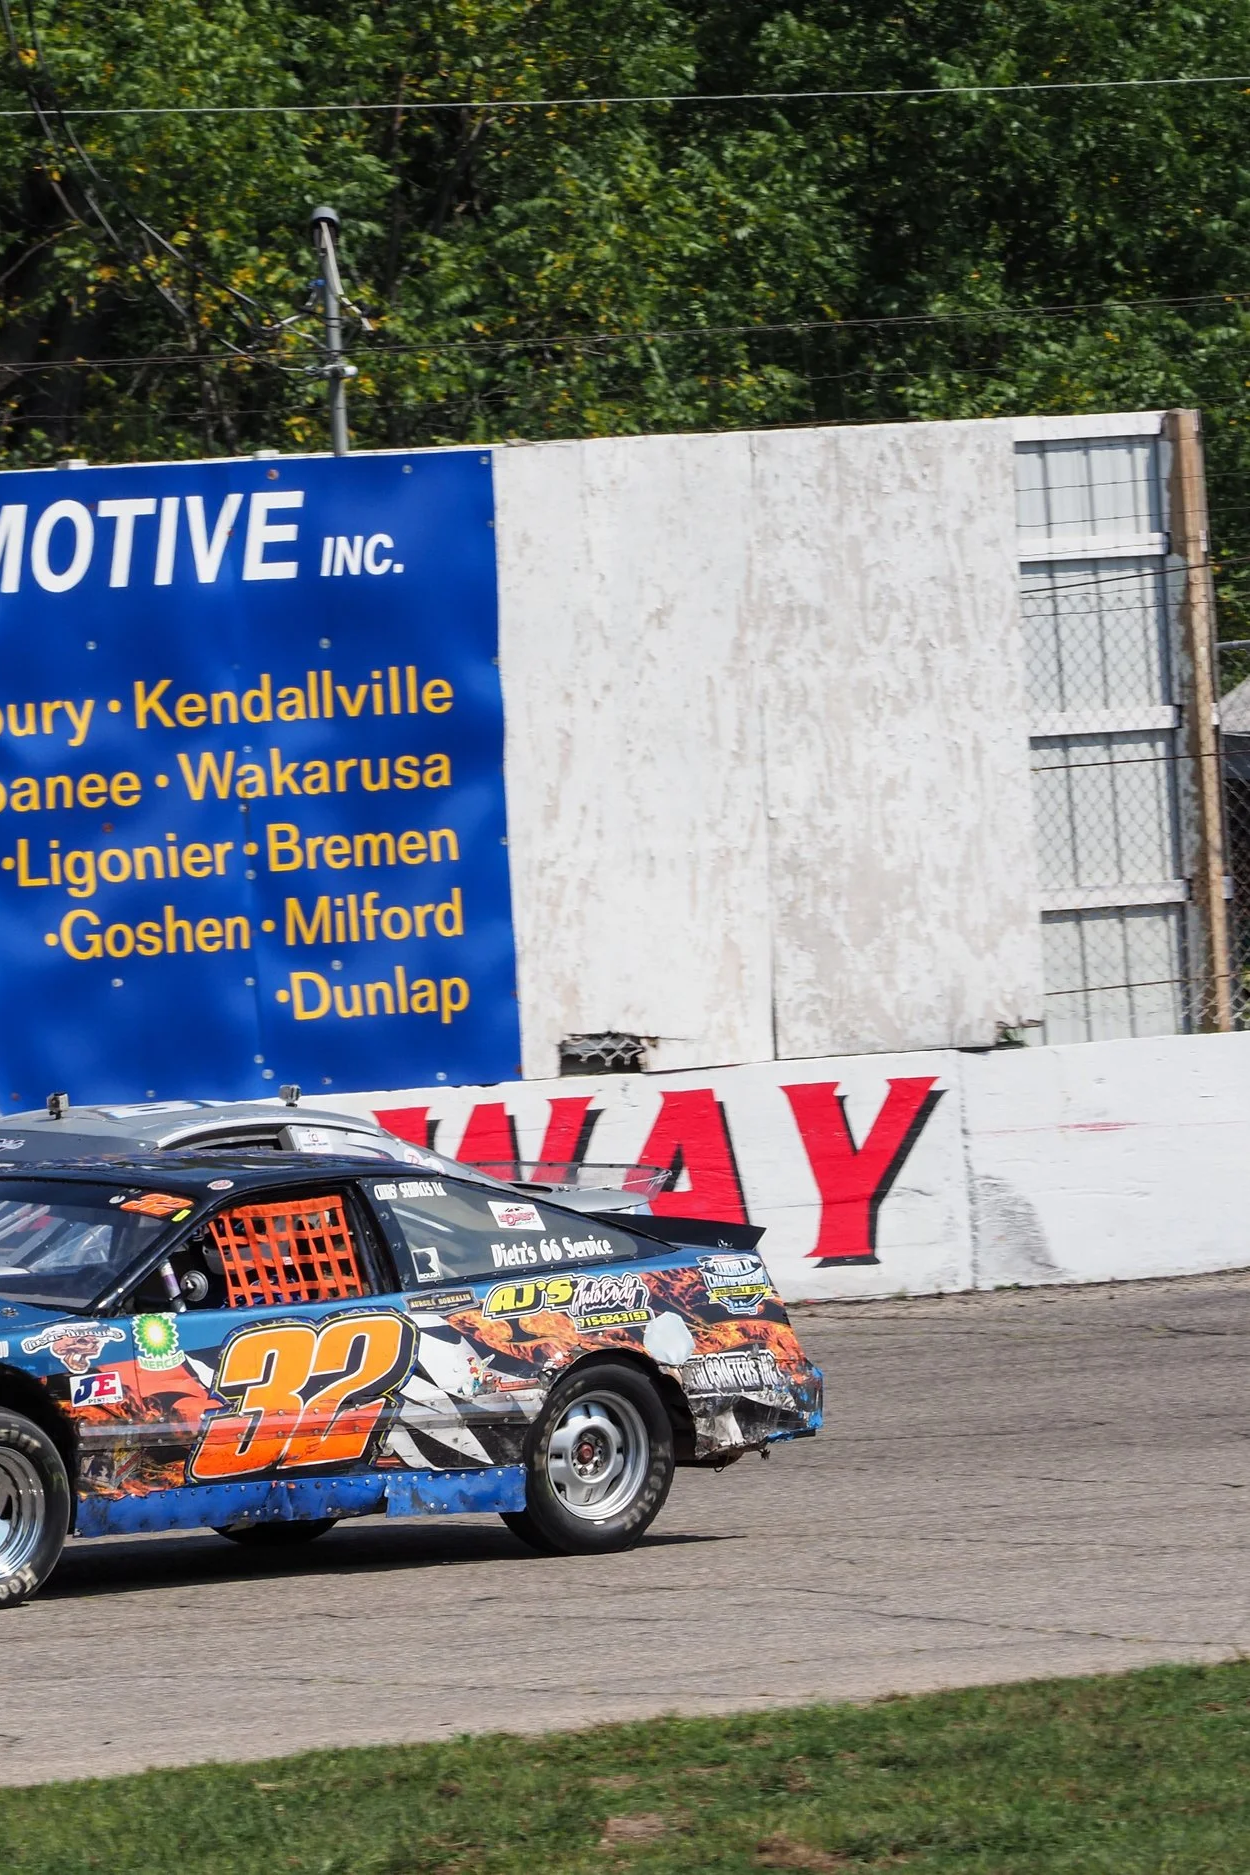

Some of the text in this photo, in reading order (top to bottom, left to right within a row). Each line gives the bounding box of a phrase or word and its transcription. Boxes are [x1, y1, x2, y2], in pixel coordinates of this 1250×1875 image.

[321, 533, 405, 577] INC.
[135, 666, 453, 728] Kendallville
[178, 749, 451, 800] Wakarusa
[17, 823, 458, 897] Ligonier Bremen
[61, 888, 463, 961] Goshen Milford
[291, 967, 469, 1023] Dunlap
[188, 1311, 412, 1482] 32
